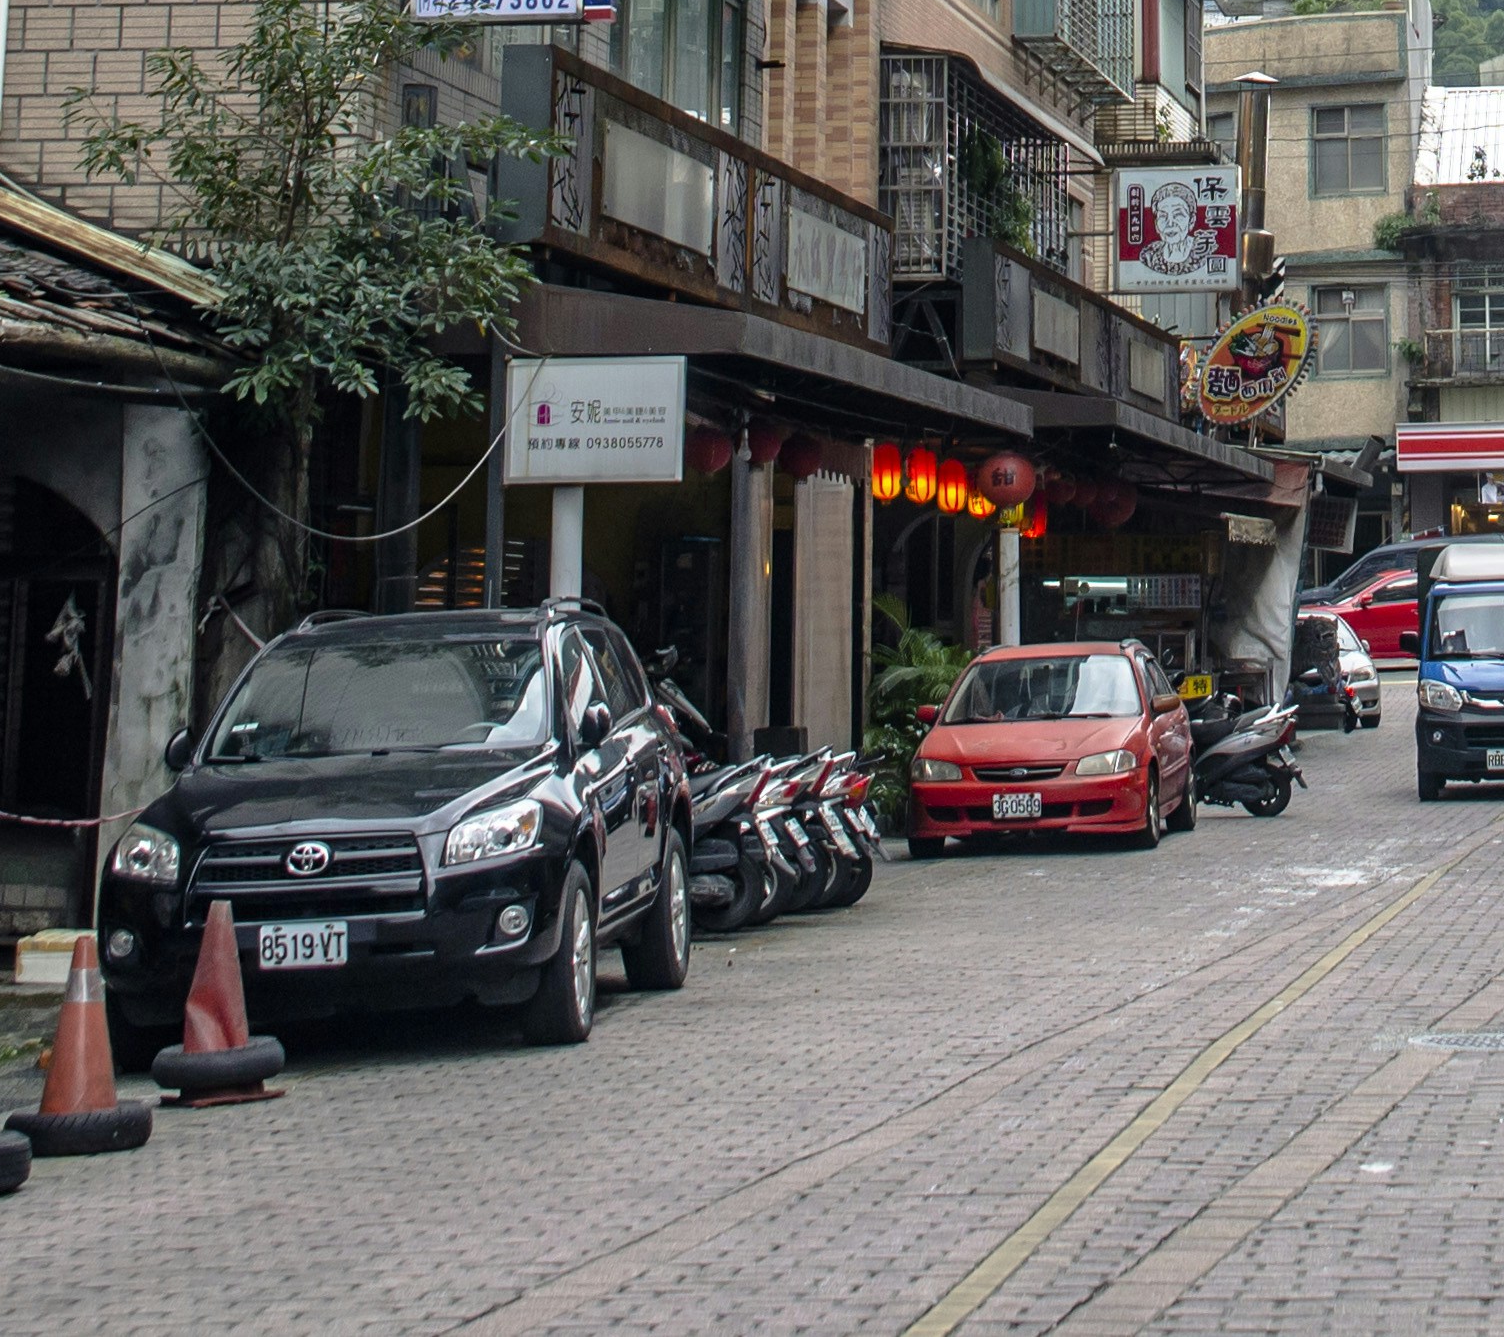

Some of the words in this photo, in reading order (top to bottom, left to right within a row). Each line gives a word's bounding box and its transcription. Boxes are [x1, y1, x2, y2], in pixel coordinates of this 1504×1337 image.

[570, 399, 601, 424] 安妮
[528, 437, 580, 450] 預約專線
[586, 437, 664, 449] 0938055778
